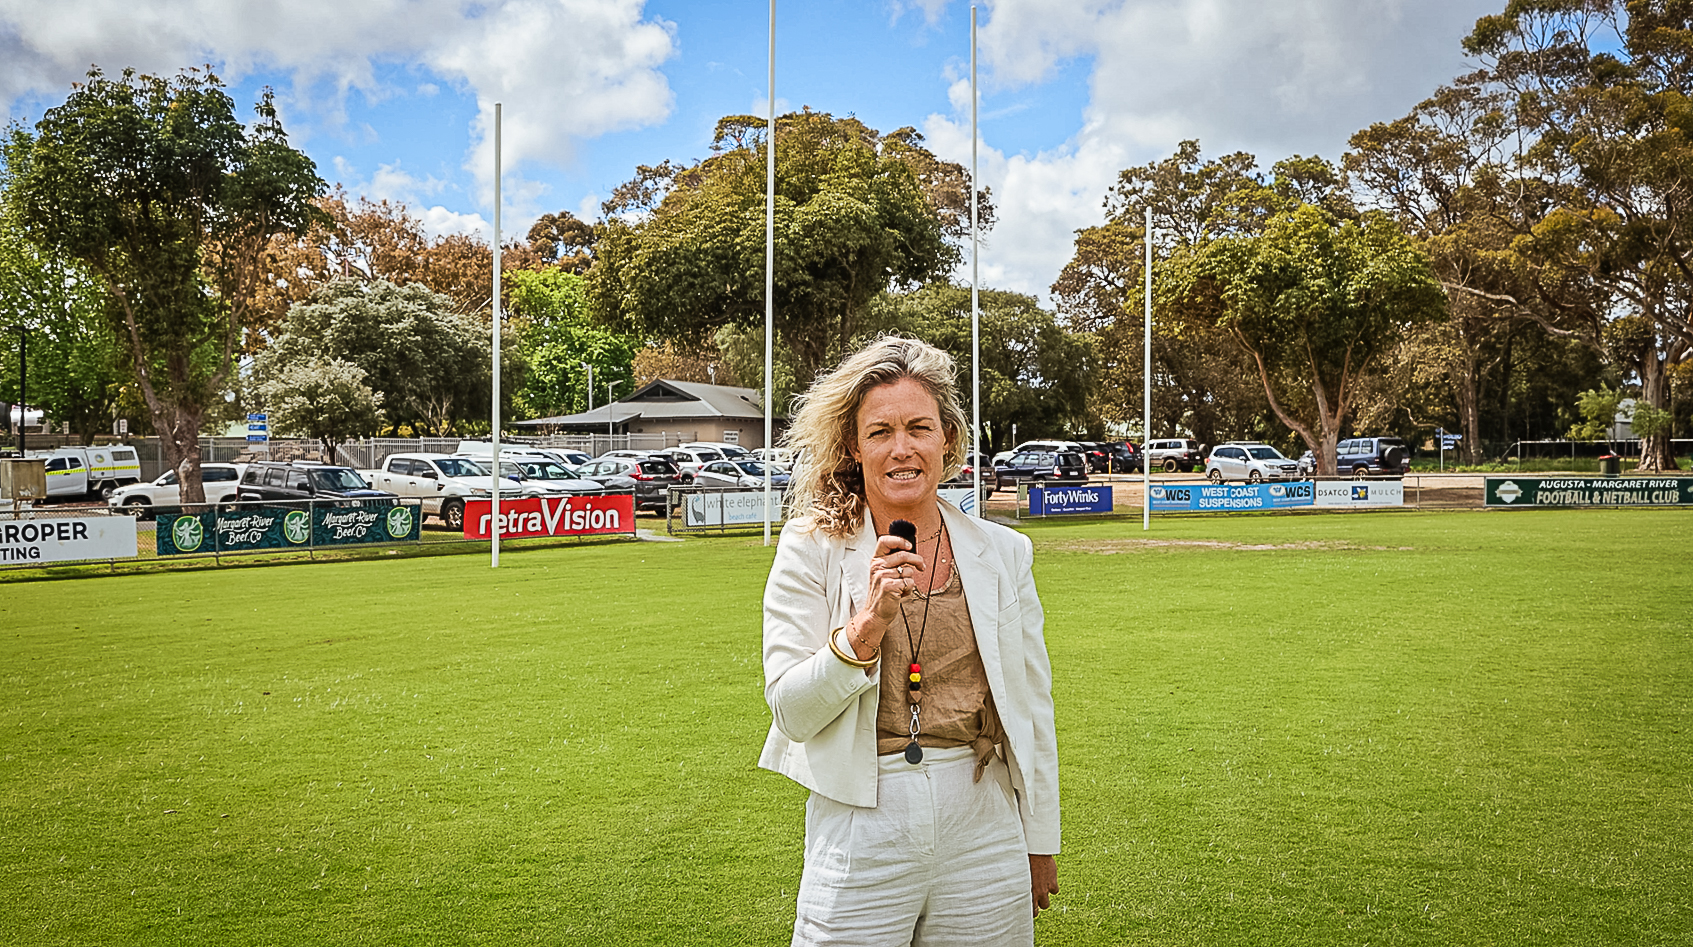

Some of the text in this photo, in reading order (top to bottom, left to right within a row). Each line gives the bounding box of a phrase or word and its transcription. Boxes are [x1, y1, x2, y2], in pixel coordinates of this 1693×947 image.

[1538, 480, 1586, 489] AUGUSTA
[1592, 480, 1648, 489] MARGARET
[1649, 480, 1679, 488] RIVER
[1165, 489, 1191, 501] WCS
[1201, 487, 1260, 498] WEST COAST
[1285, 485, 1311, 498] WCS
[1318, 488, 1402, 497] DSATCO MULCH
[1536, 490, 1680, 504] FOOTBALL & NETBALL CLUB
[706, 497, 735, 509] whte
[1198, 497, 1263, 508] SUSPENSIONS
[322, 510, 379, 529] Margaret River
[479, 498, 620, 536] retraVision
[213, 514, 275, 534] Margaret River
[0, 522, 89, 544] ROPER
